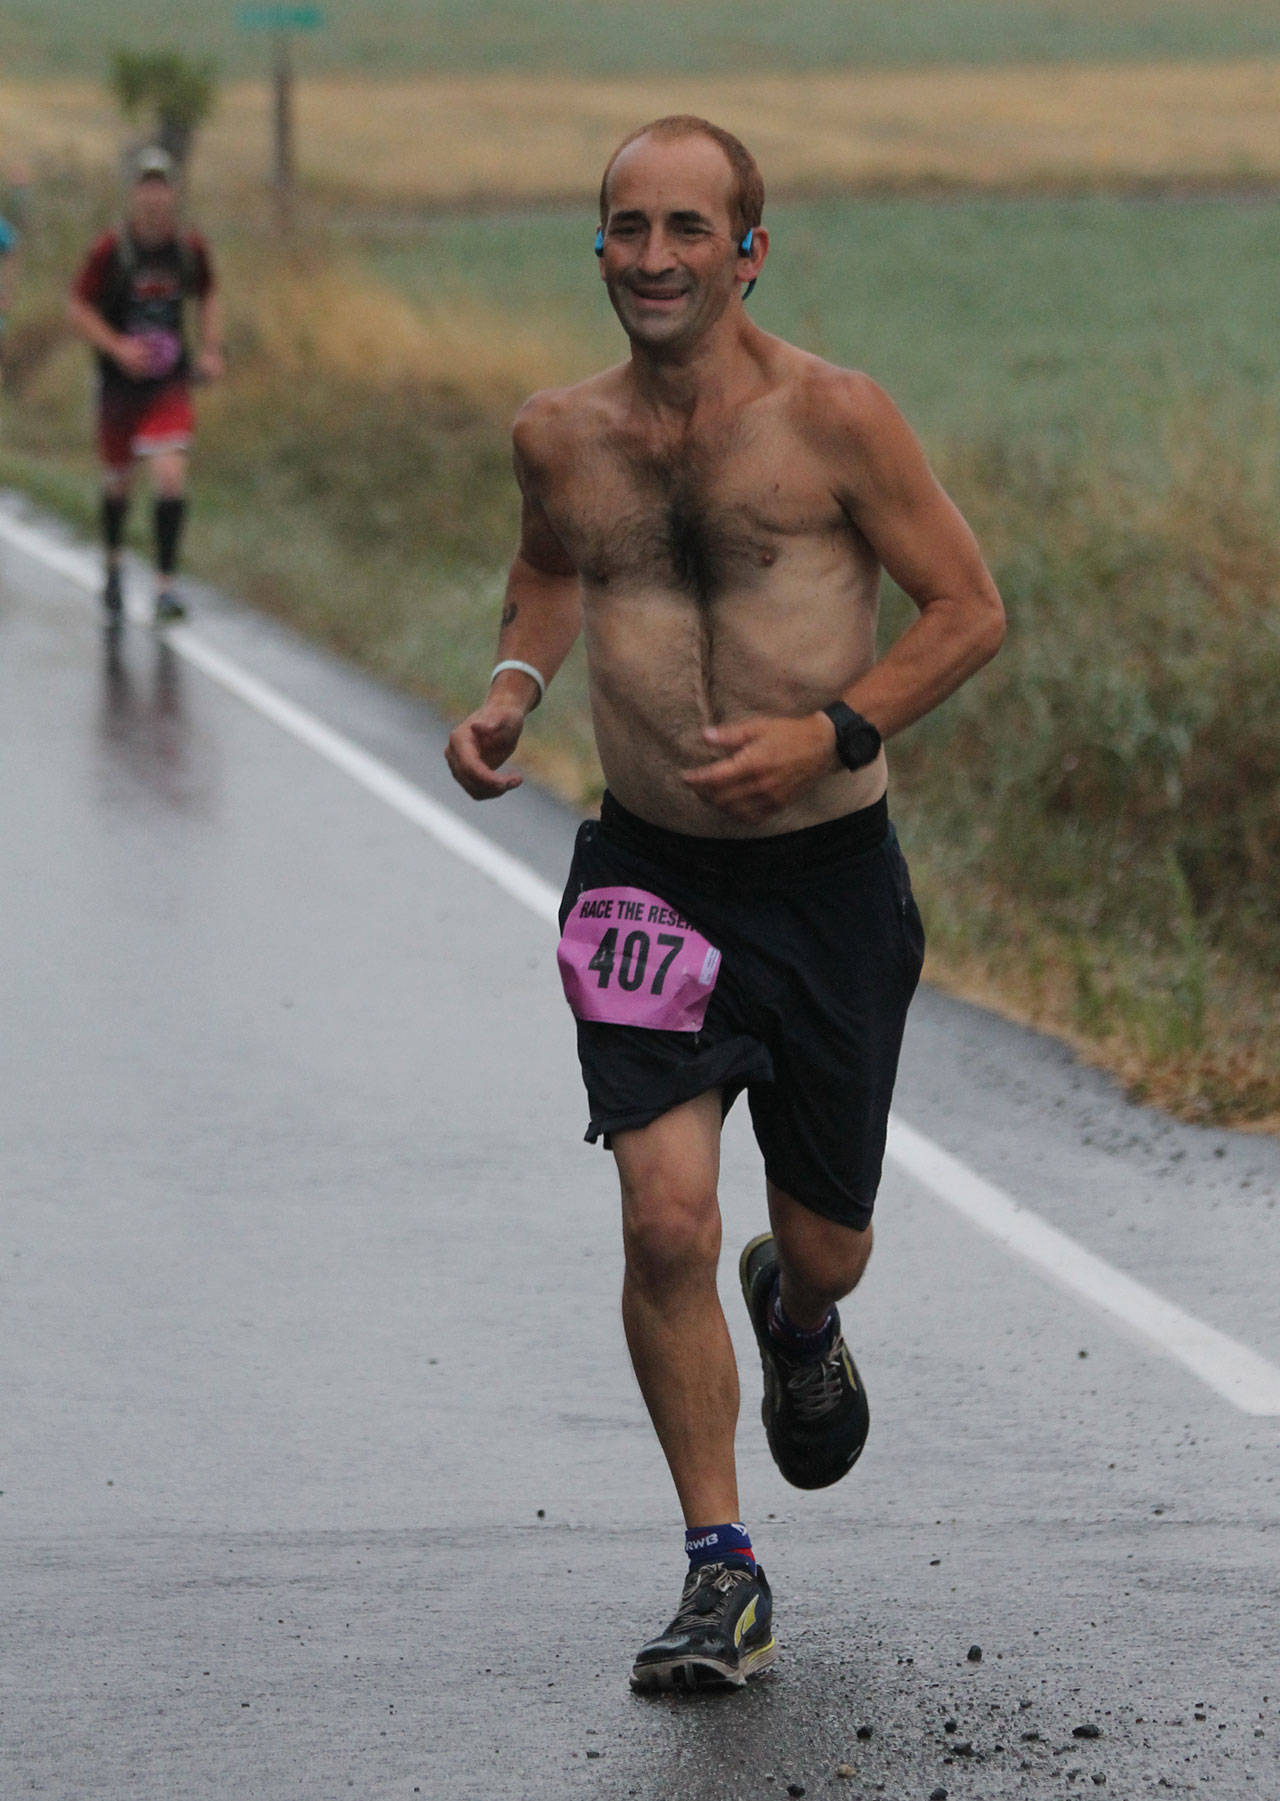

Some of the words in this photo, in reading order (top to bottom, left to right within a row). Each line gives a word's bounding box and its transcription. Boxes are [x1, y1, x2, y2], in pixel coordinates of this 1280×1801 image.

[580, 901, 613, 918] RACE
[618, 901, 645, 921] THE
[588, 928, 684, 995] 407
